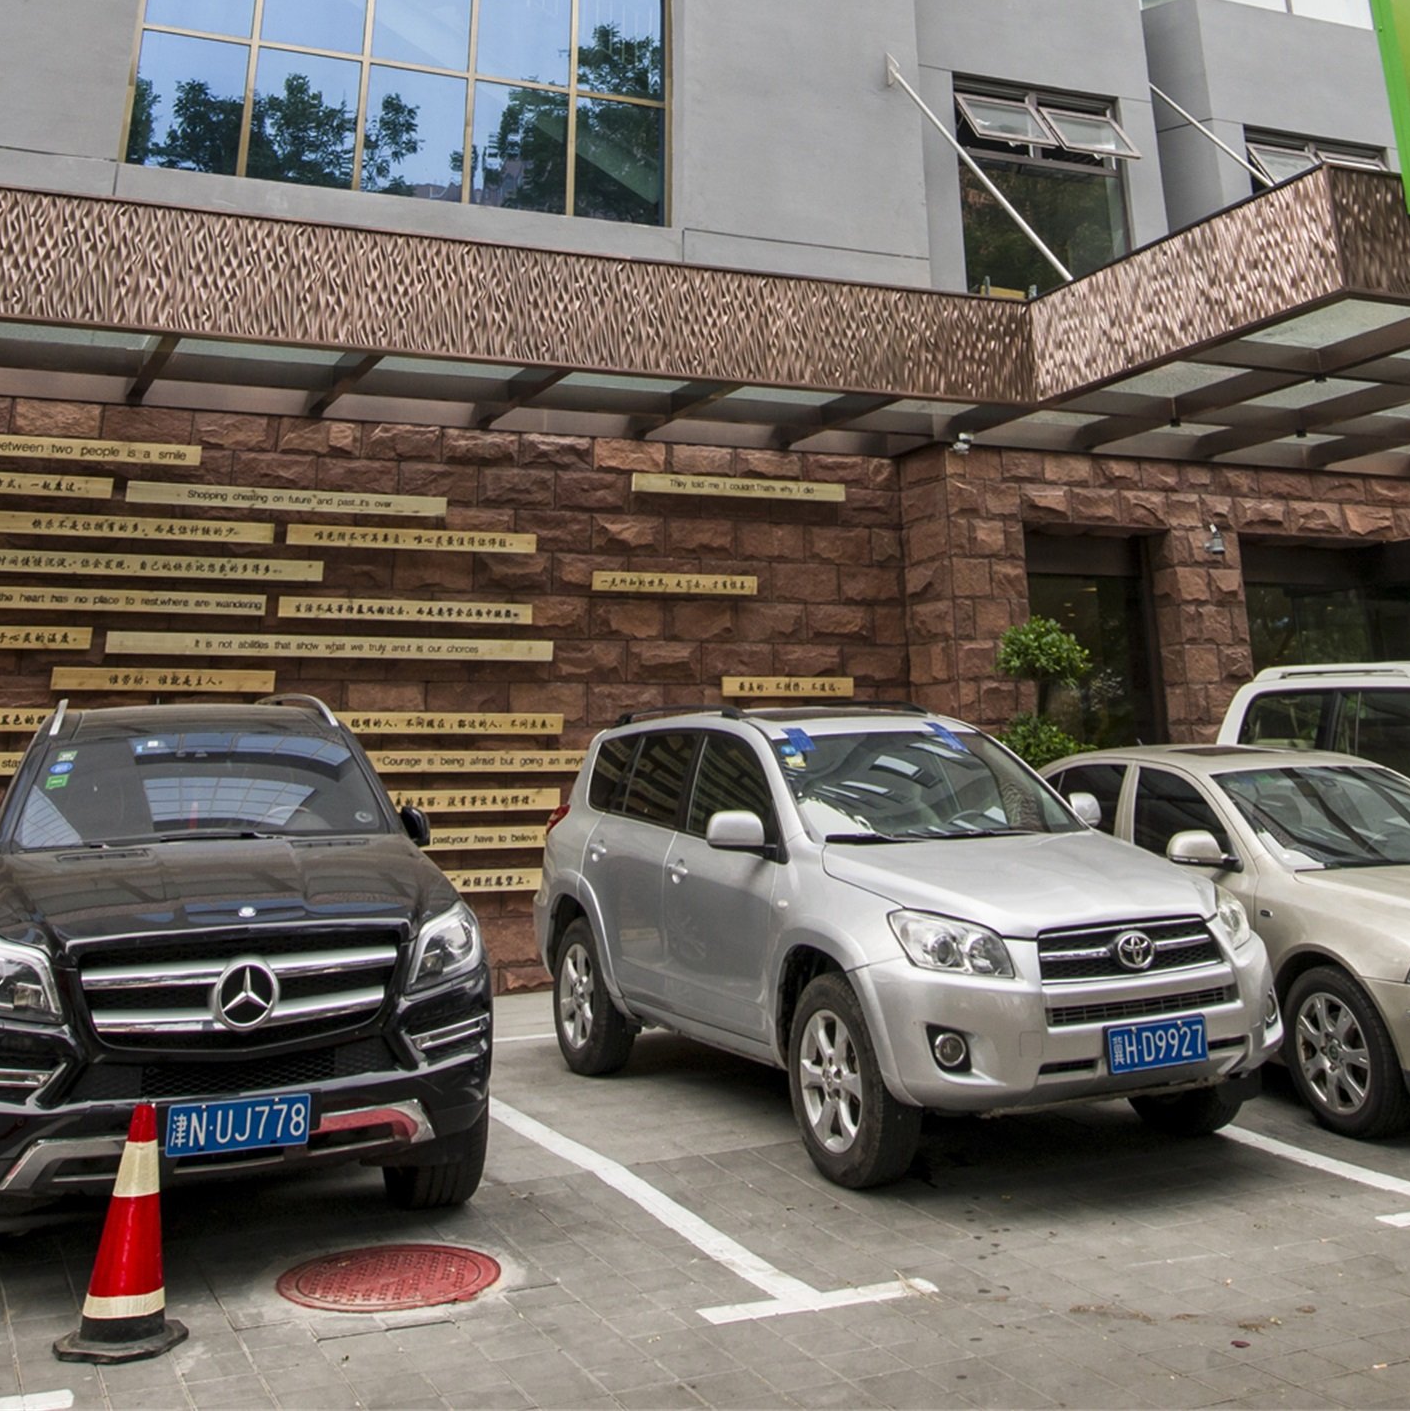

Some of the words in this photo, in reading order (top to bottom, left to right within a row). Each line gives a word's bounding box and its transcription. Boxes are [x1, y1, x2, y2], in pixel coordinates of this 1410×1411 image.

[51, 444, 73, 454] two
[80, 445, 120, 458] people
[127, 447, 137, 458] is
[143, 450, 151, 459] a
[158, 449, 187, 461] smile
[670, 479, 687, 489] They
[691, 480, 705, 489] told
[780, 485, 793, 494] why
[803, 485, 814, 494] did
[187, 489, 228, 502] Shopping
[232, 492, 269, 503] cheating
[288, 494, 312, 504] future
[316, 496, 333, 505] and
[374, 500, 393, 508] over
[19, 593, 45, 602] heart
[50, 594, 69, 603] has
[74, 595, 88, 604] no
[93, 595, 120, 606] place
[125, 596, 135, 605] to
[194, 599, 210, 607] are
[215, 599, 262, 610] wandering
[194, 638, 200, 648] It
[205, 639, 212, 648] is
[218, 640, 233, 649] not
[238, 640, 269, 649] abilities
[274, 641, 291, 650] that
[296, 641, 319, 650] show
[325, 641, 346, 651] what
[369, 644, 387, 655] truly
[416, 644, 423, 653] is
[428, 645, 442, 653] our
[427, 756, 435, 766] is
[440, 756, 465, 767] being
[469, 756, 495, 766] afraid
[500, 756, 514, 766] but
[519, 757, 544, 768] going
[548, 757, 560, 765] an
[473, 834, 494, 844] have
[498, 834, 507, 843] to
[511, 833, 538, 843] believe
